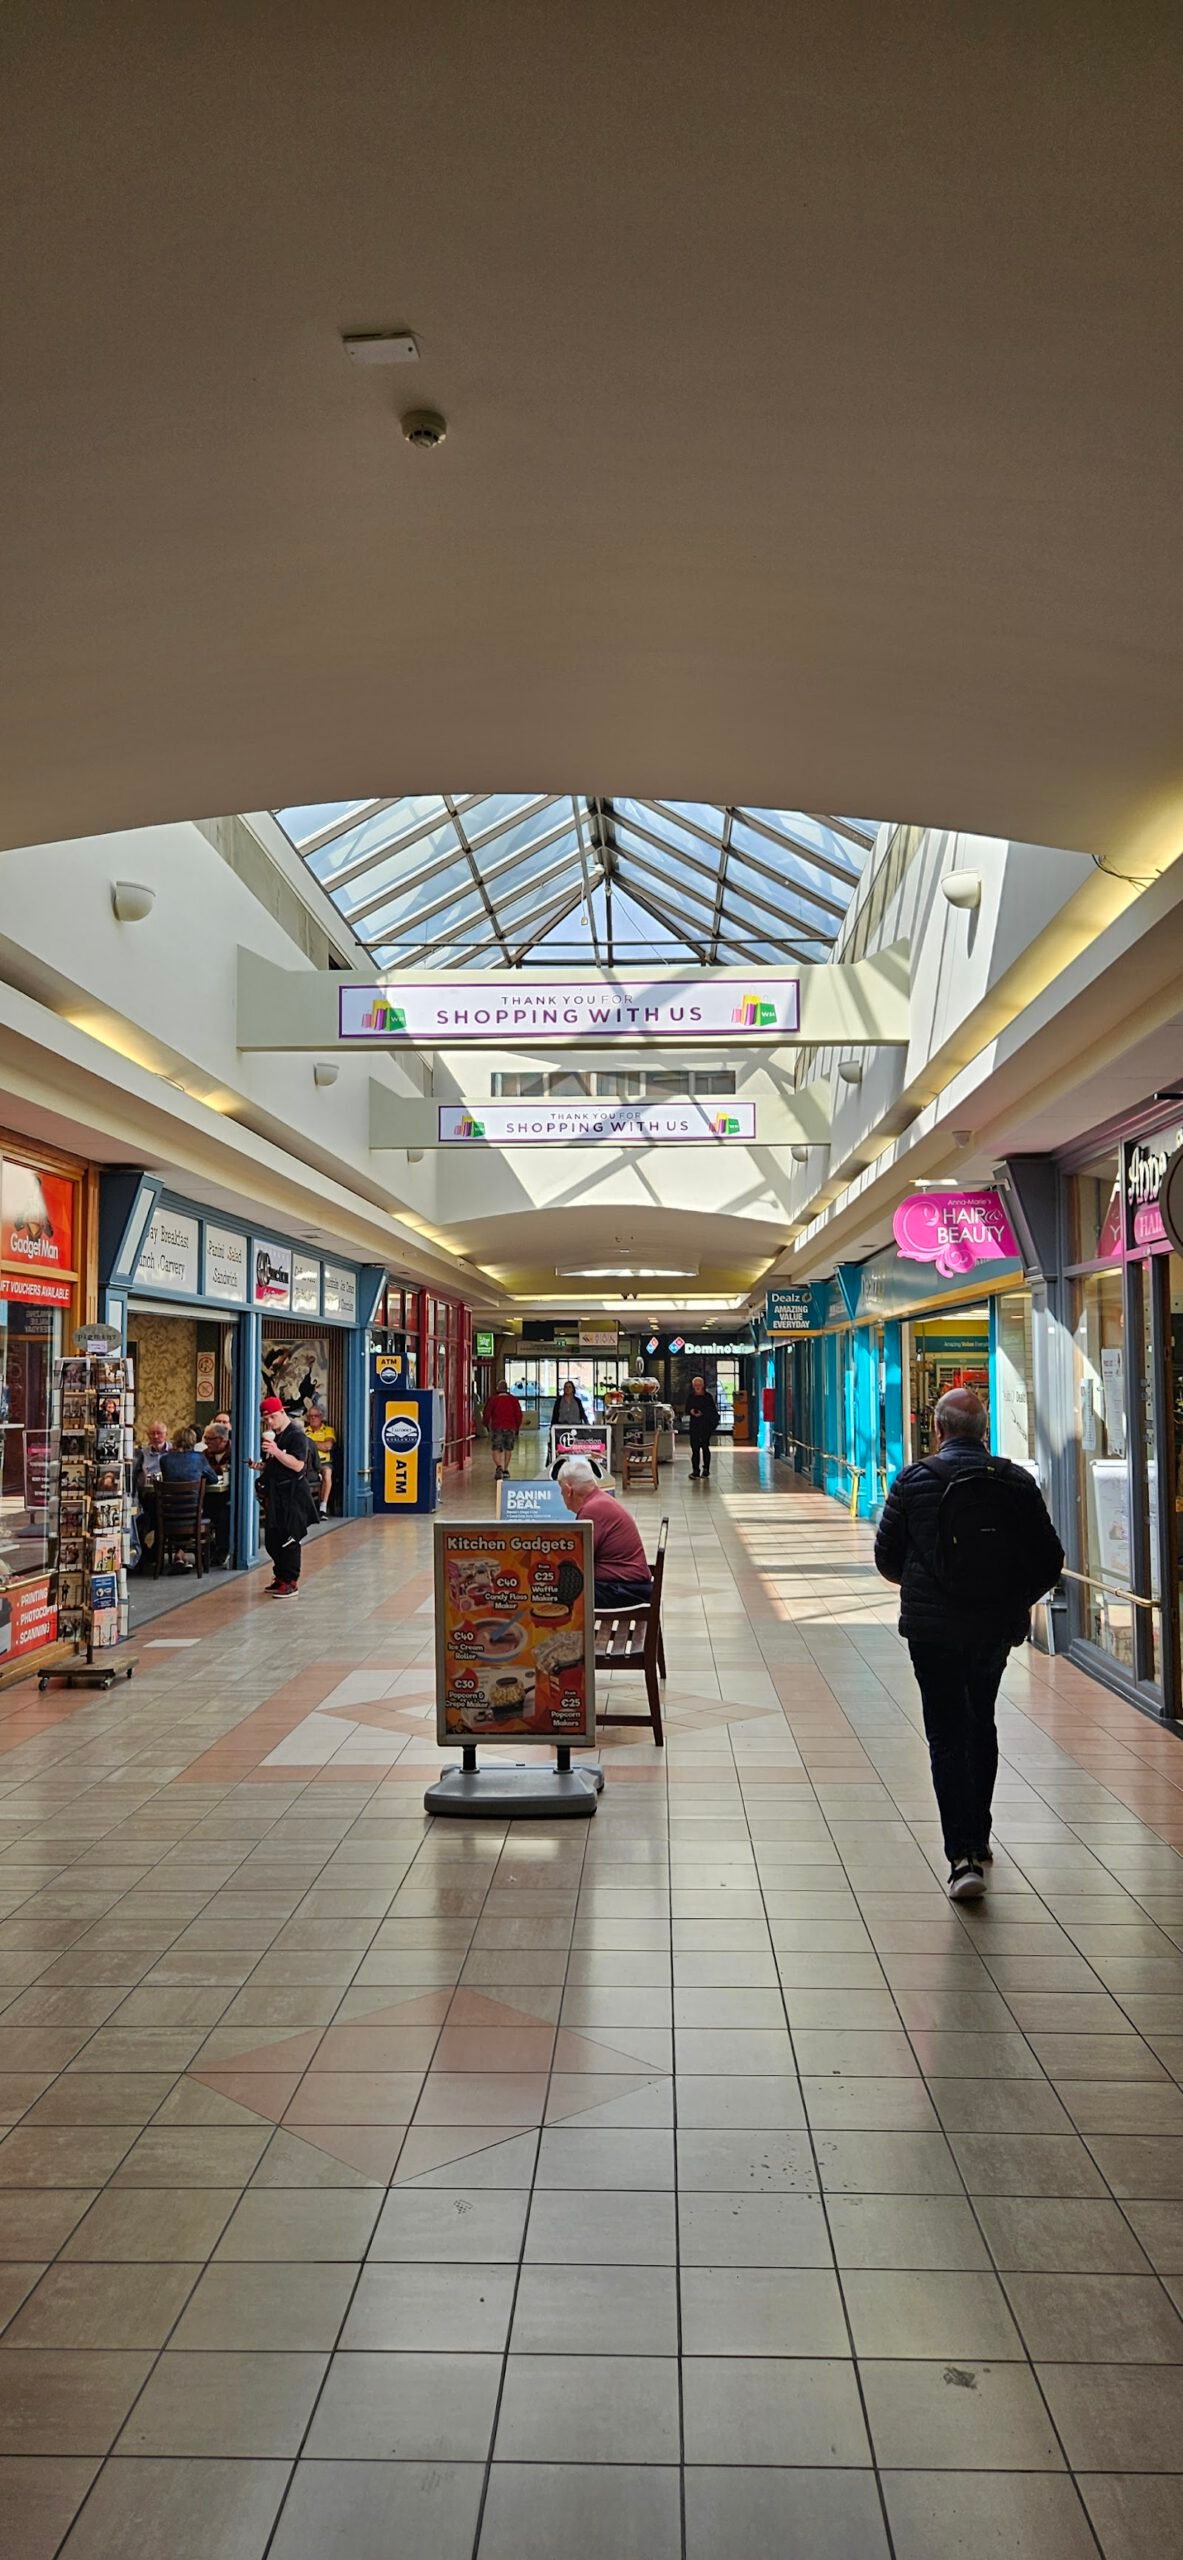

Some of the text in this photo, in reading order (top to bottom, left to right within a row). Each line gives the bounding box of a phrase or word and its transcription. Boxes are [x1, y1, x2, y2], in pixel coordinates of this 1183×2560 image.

[502, 994, 633, 1005] THANK YOU FOR
[437, 1006, 703, 1024] SHOPPING WITH US
[592, 1112, 616, 1120] YOU
[506, 1120, 689, 1133] SHOPPING WITH US
[943, 1207, 985, 1225] HAIR
[146, 1226, 158, 1245] ay
[937, 1225, 1005, 1244] BEAUTY
[10, 1233, 59, 1260] Gadget Man
[10, 1281, 41, 1297] VOUCHERS
[41, 1286, 70, 1300] AVAILABLE
[771, 1292, 801, 1303] Dealz
[774, 1305, 809, 1314] AMAZING
[779, 1313, 803, 1321] VALUE
[773, 1320, 810, 1329] EVERYDAY
[395, 1460, 407, 1494] ATM
[507, 1490, 551, 1500] PANINI
[507, 1500, 541, 1509] DEAL
[447, 1537, 575, 1553] Kitchen Gadgets
[534, 1572, 554, 1581] €25
[496, 1578, 518, 1588] €40
[21, 1587, 48, 1607] PRINTING
[485, 1593, 509, 1602] Candy
[453, 1631, 474, 1641] €40
[454, 1679, 474, 1689] €30
[448, 1691, 478, 1700] Popcorn
[561, 1698, 581, 1708] €25
[551, 1710, 581, 1719] Popcorn
